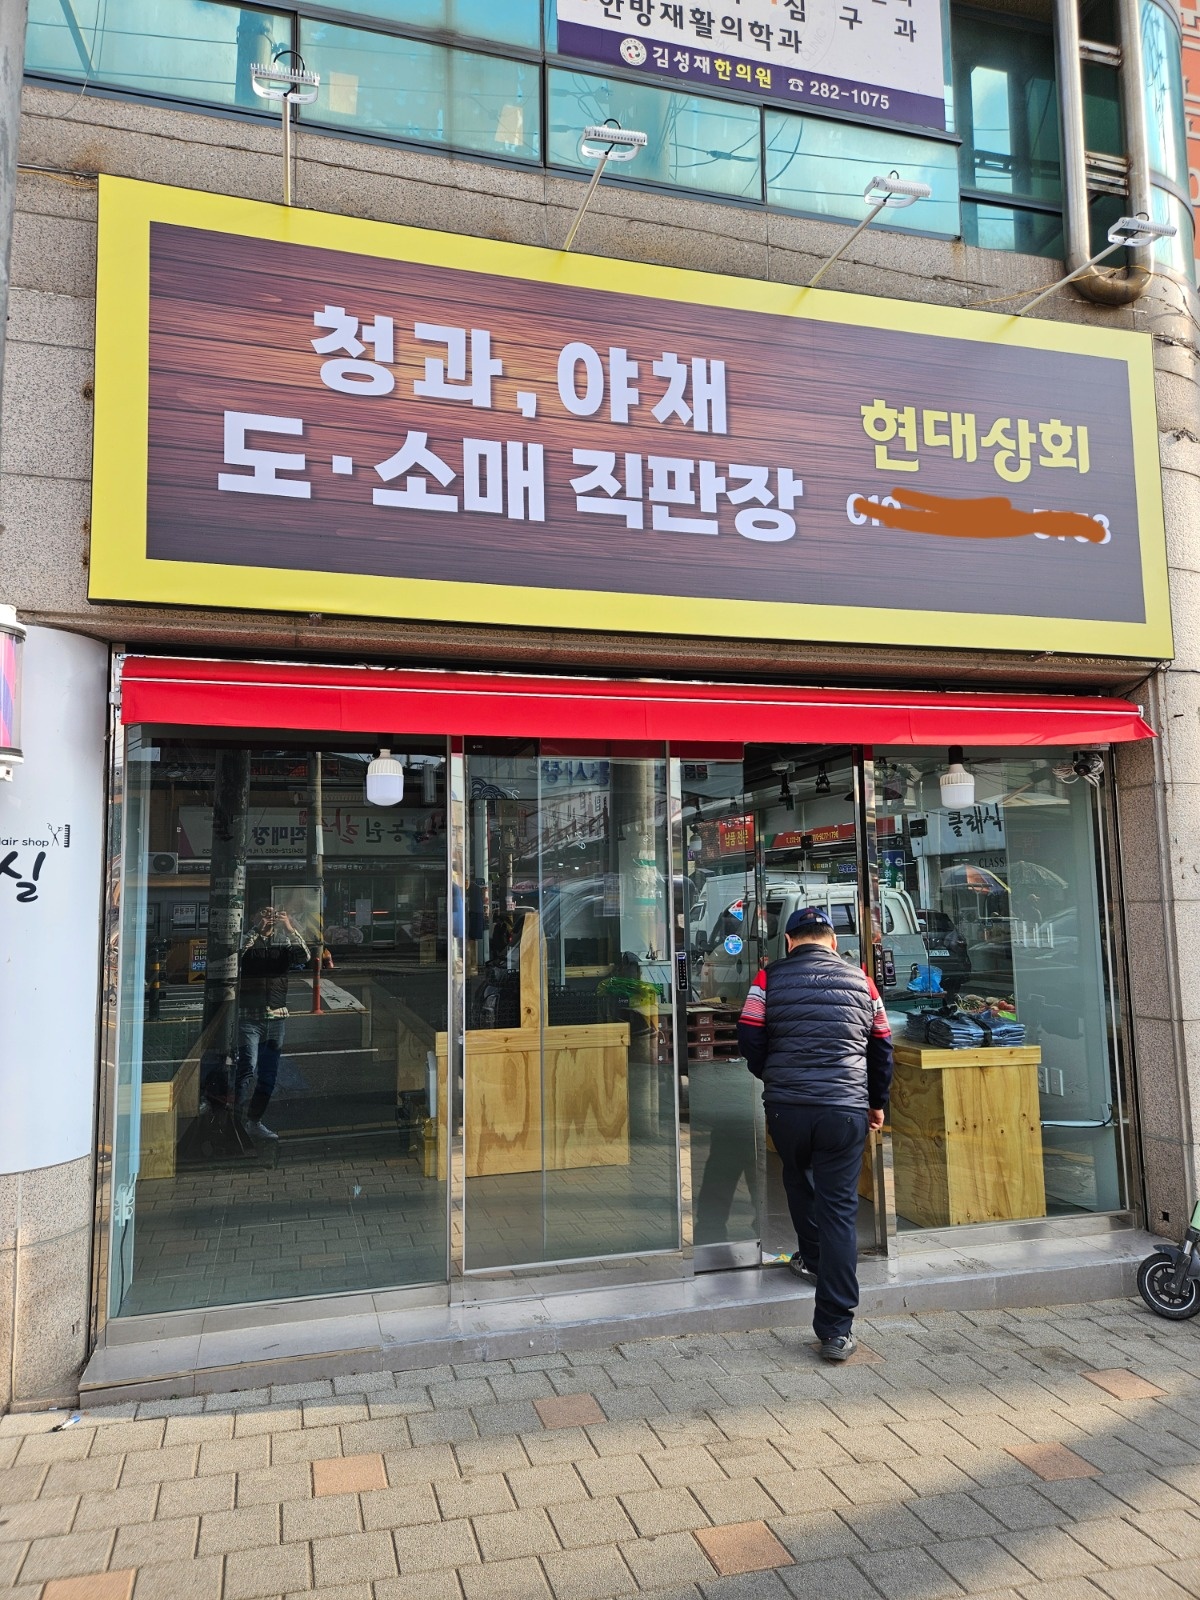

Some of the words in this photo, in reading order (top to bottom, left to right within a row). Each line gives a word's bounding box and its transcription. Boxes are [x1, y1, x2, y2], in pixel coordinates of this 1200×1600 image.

[652, 46, 772, 89] 김성재한의원
[809, 81, 890, 110] 282-1075
[860, 398, 1091, 484] 현대상회
[569, 448, 804, 543] 직판장
[0, 837, 19, 846] air
[22, 837, 50, 848] shop
[947, 803, 1003, 837] 클래식
